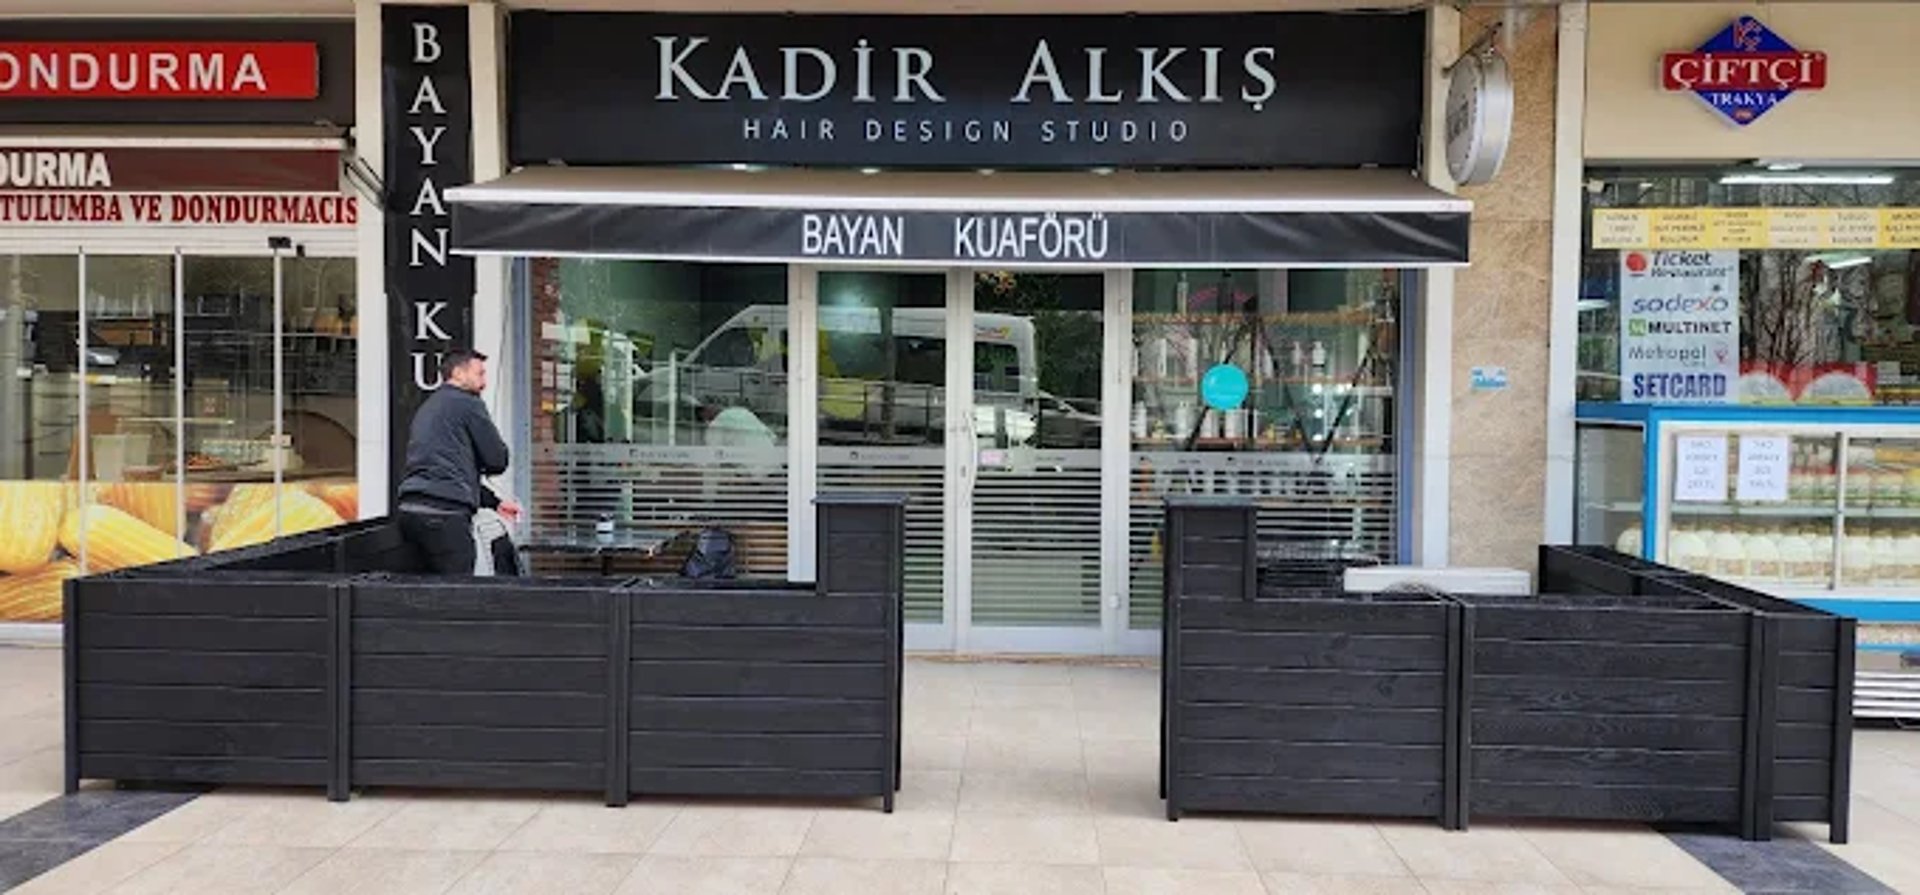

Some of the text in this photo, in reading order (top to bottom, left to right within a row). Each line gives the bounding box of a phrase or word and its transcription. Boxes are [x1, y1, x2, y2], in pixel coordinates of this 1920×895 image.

[0, 52, 267, 91] ONDURMA
[653, 36, 1278, 111] KADİR ALKIŞ
[1671, 53, 1813, 89] ÇİFTÇİ
[1712, 92, 1778, 105] TRAKYA
[408, 22, 448, 267] BAYAN
[743, 118, 1189, 143] HAIR DESIGN STUDIO
[0, 194, 358, 224] TULUMBA VE DONDURMACIS
[802, 214, 1109, 259] BAYAN KUAFÖRÜ
[1653, 251, 1713, 266] Ticket
[1632, 293, 1729, 314] sodexo
[1648, 320, 1732, 334] MULTINET
[410, 302, 453, 391] KU
[1633, 373, 1727, 398] SETCARD
